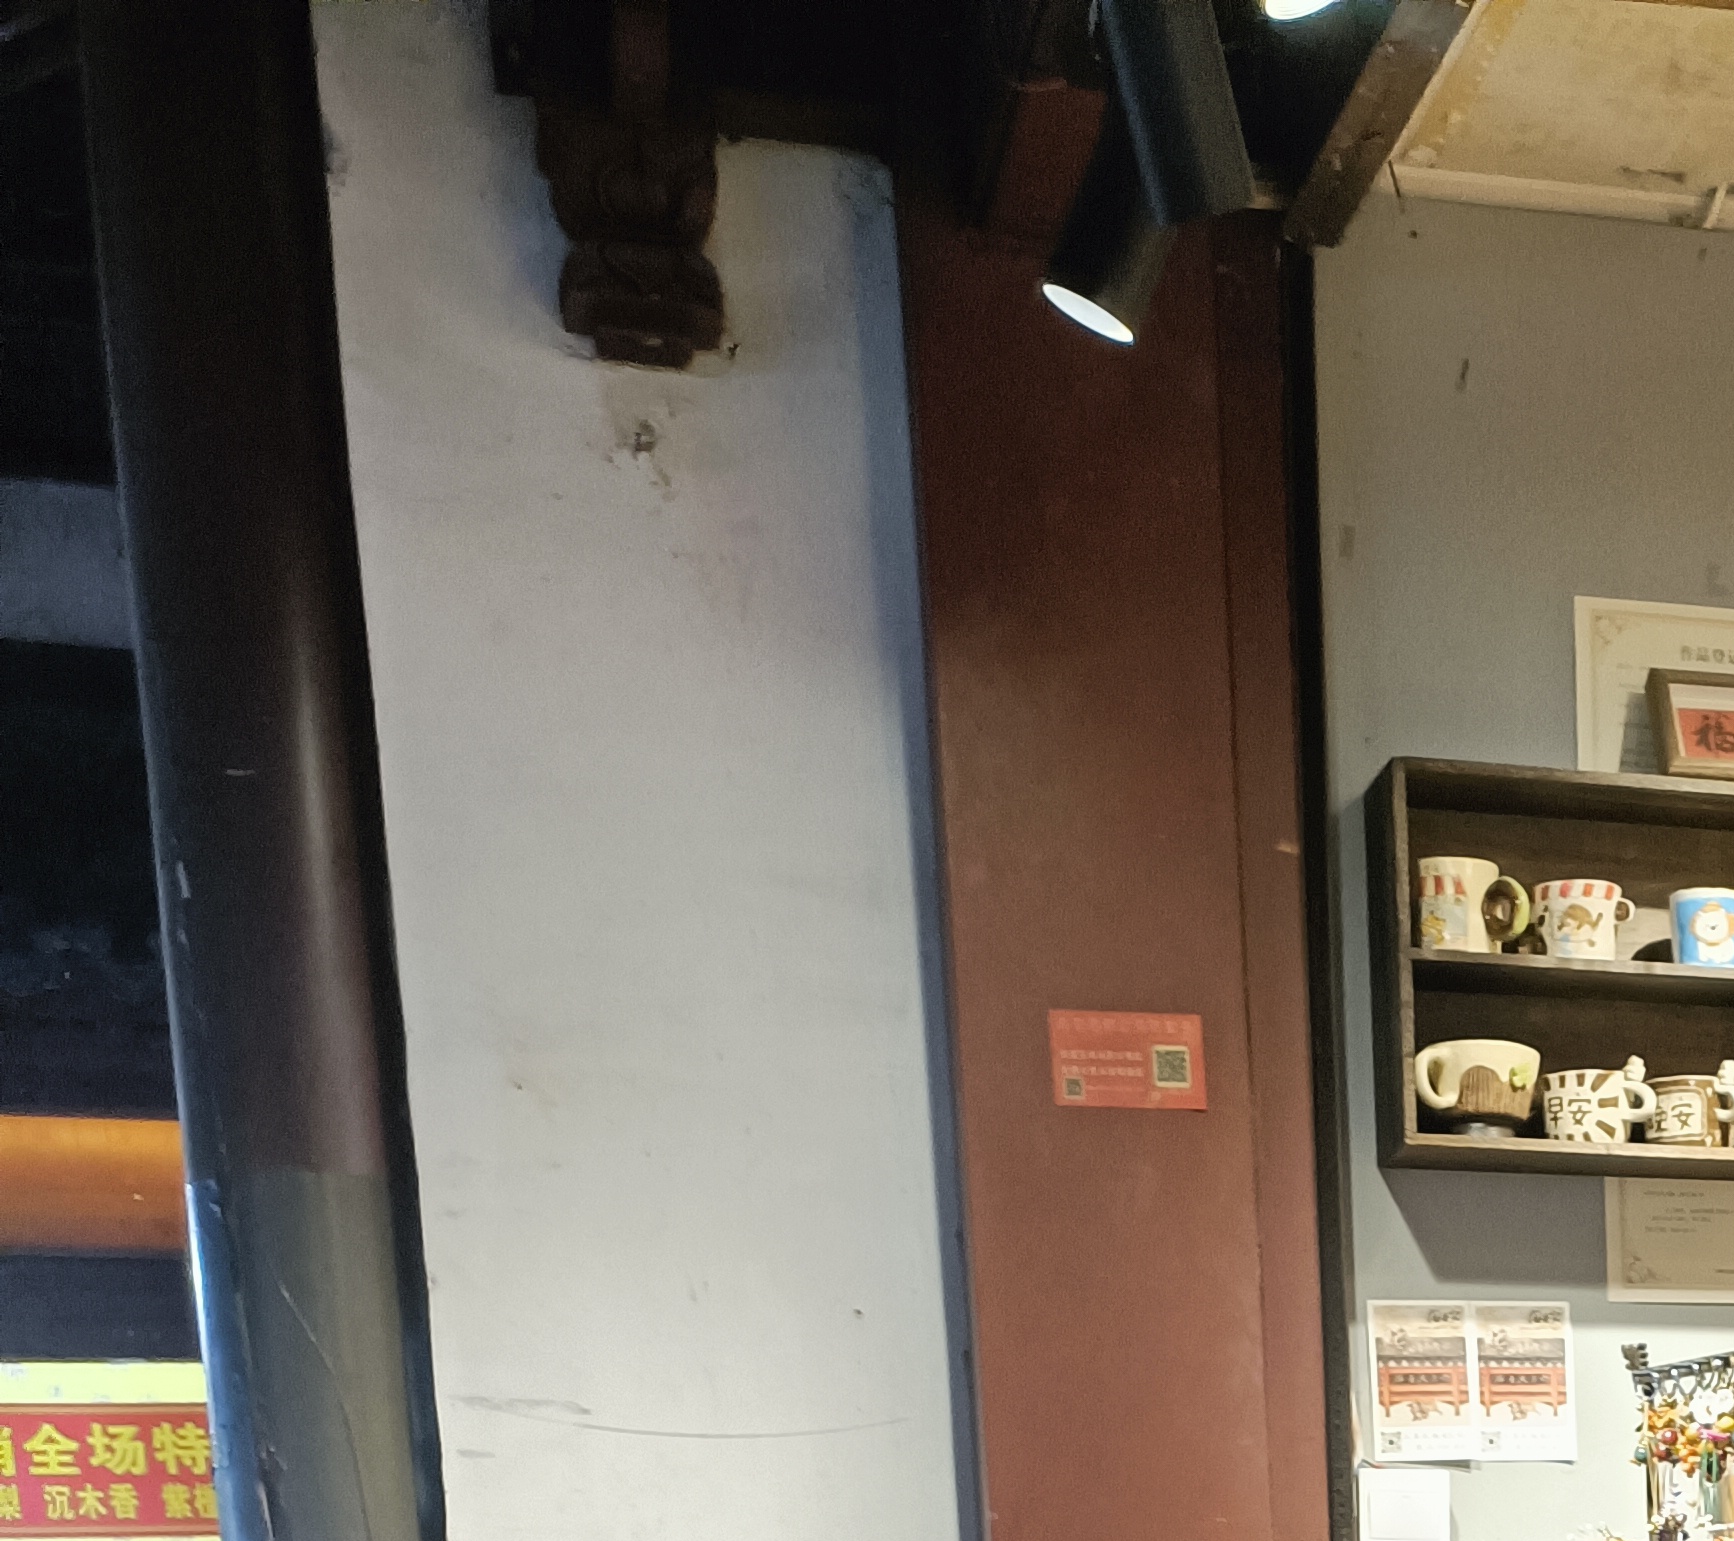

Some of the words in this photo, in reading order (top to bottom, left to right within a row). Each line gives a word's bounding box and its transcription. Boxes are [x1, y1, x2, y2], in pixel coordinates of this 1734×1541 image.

[1547, 1097, 1592, 1129] 早安
[0, 1421, 211, 1477] 全场特
[43, 1482, 141, 1521] 沉木香
